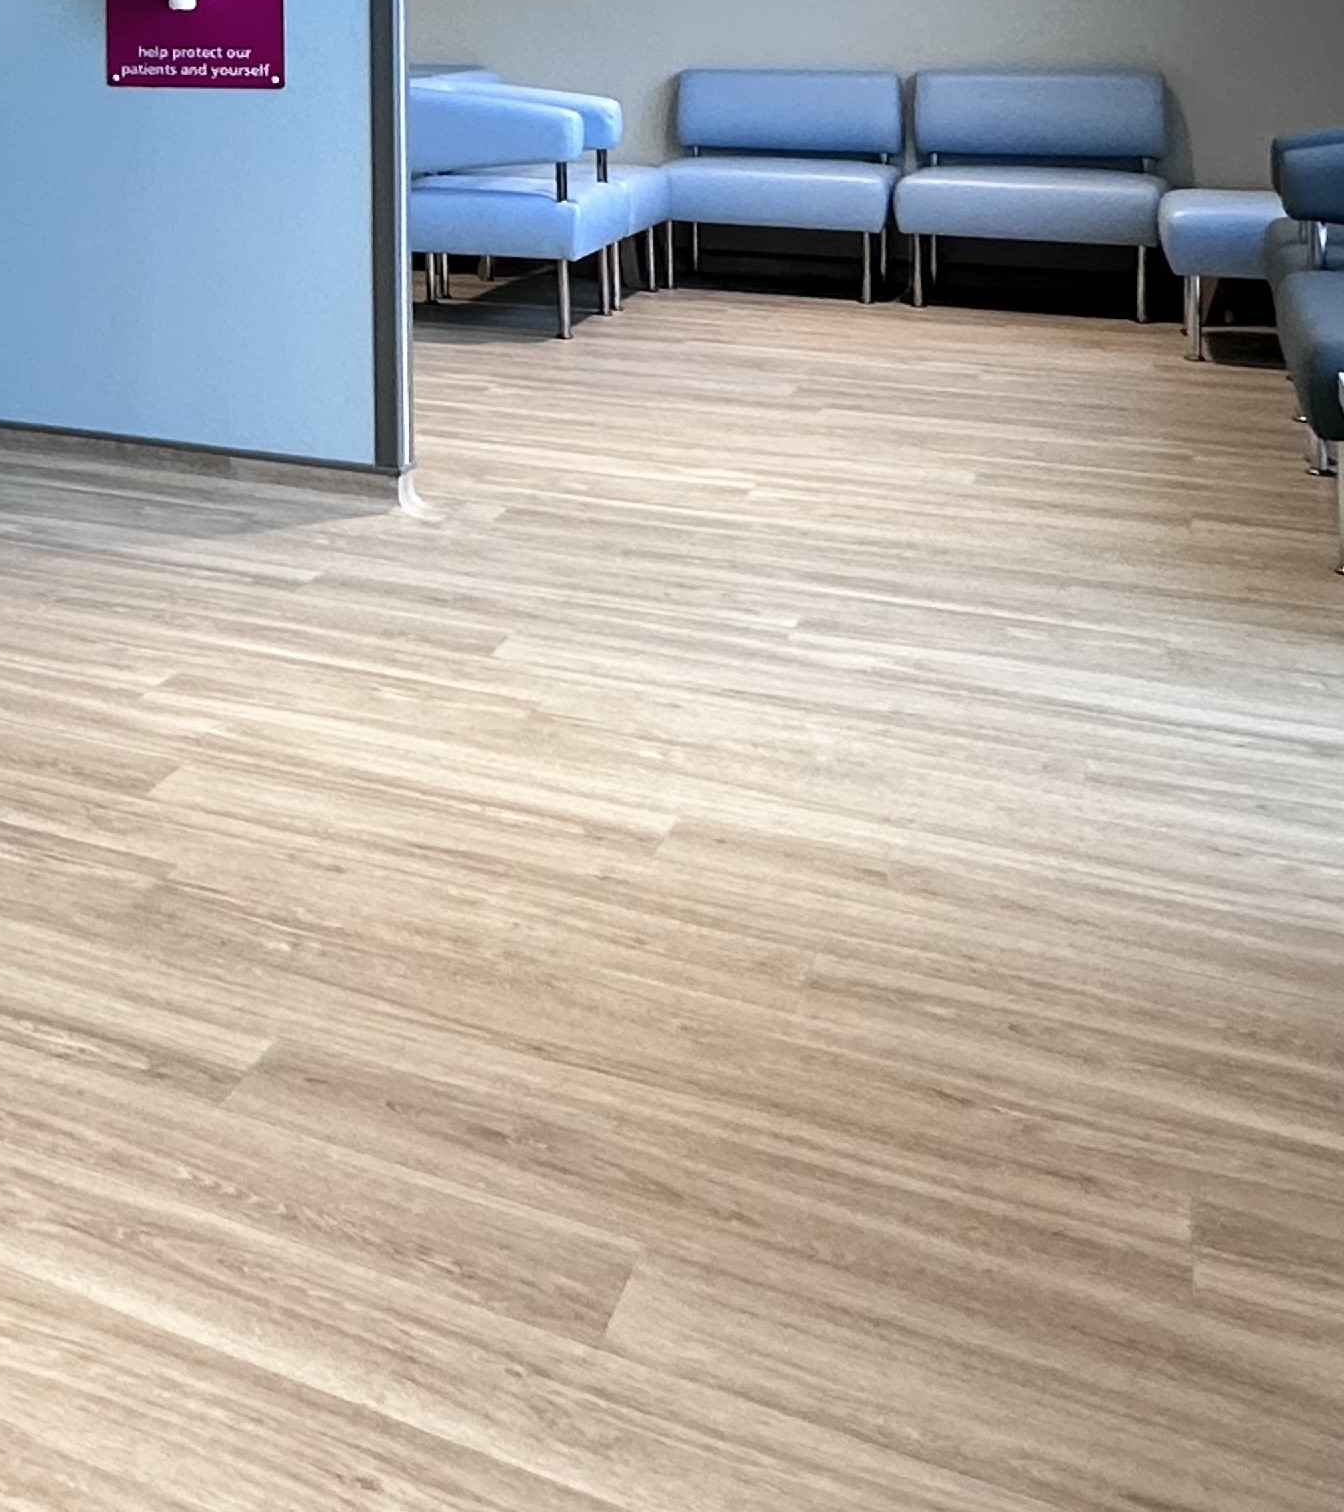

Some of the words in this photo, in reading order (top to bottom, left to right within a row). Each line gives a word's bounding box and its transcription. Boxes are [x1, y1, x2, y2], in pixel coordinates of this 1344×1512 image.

[138, 45, 169, 60] help
[172, 46, 223, 61] protect
[226, 48, 252, 60] our
[121, 62, 178, 78] patients
[180, 63, 208, 76] and
[211, 63, 271, 79] yourself
